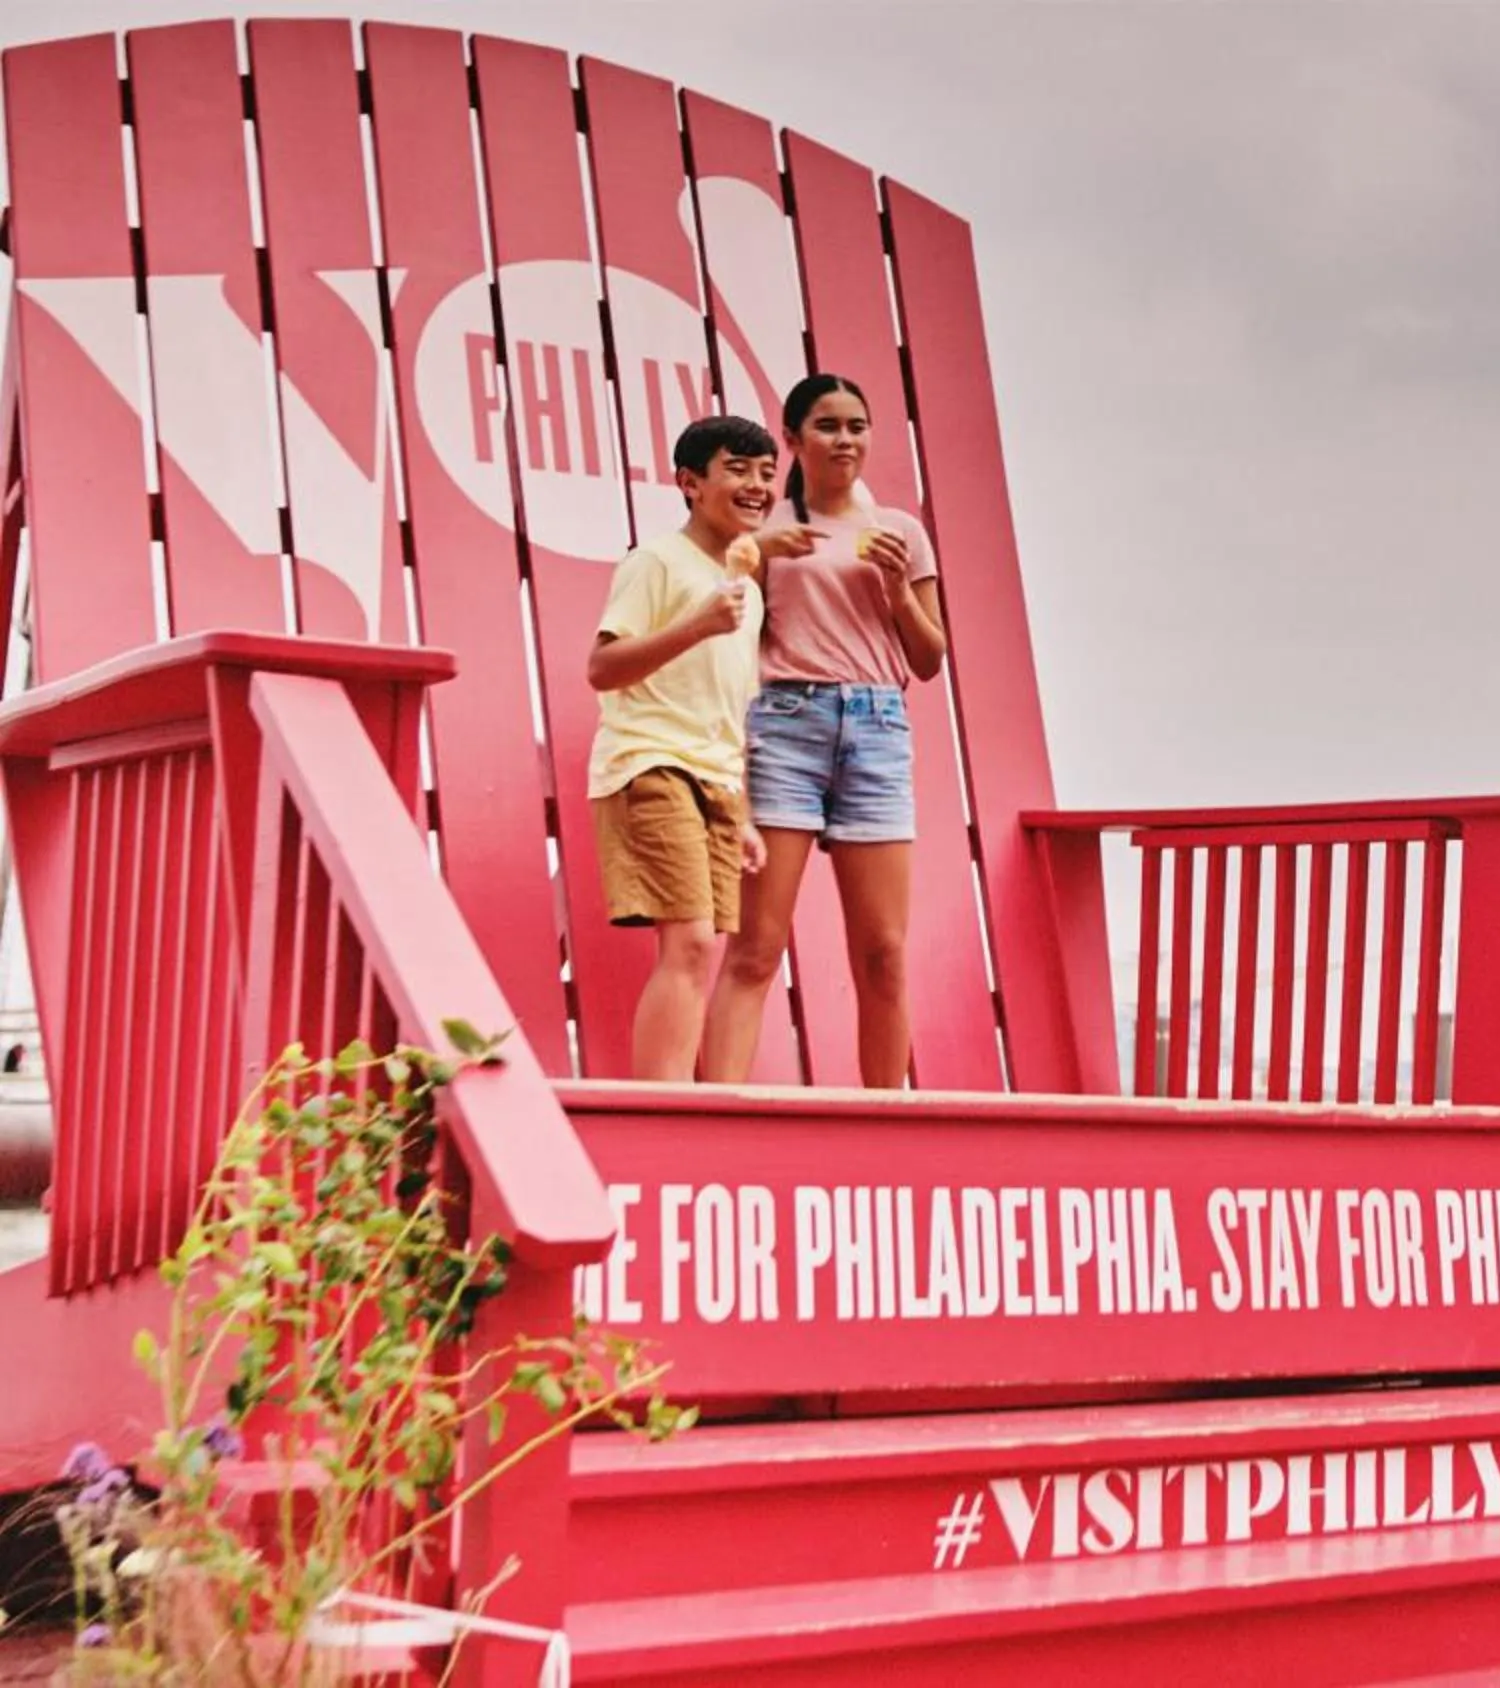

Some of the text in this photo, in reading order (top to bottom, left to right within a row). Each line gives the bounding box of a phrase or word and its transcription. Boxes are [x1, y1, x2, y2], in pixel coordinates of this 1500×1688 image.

[660, 1183, 780, 1324] FOR
[794, 1185, 1198, 1322] PHILADELPHIA.
[1206, 1187, 1323, 1313] STAY
[1335, 1188, 1429, 1309] FOR
